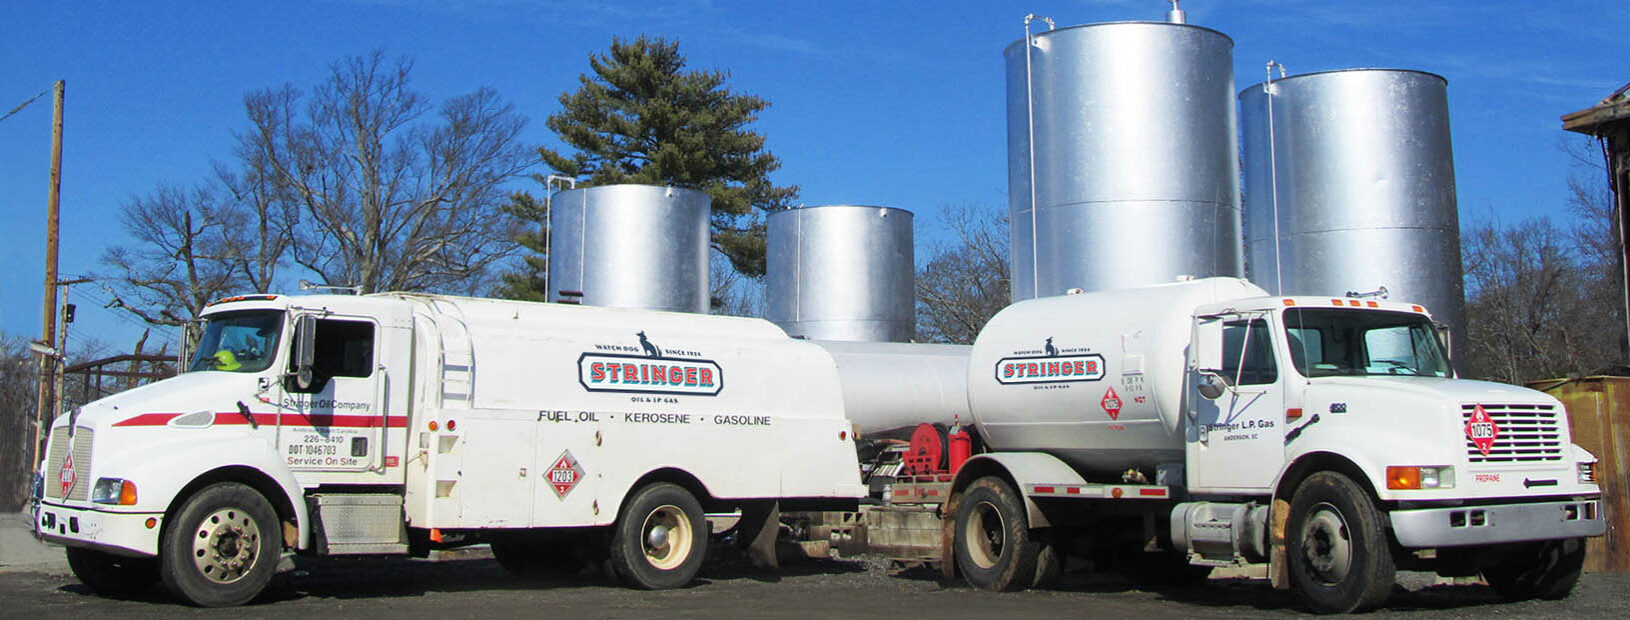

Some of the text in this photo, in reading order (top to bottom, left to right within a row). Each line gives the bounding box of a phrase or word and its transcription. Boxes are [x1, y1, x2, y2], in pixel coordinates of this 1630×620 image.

[591, 362, 714, 387] STRINGER
[1004, 361, 1099, 378] STRINGER
[331, 400, 371, 411] Company
[539, 410, 599, 422] FUEL OIL
[624, 413, 691, 424] KEROSENE
[714, 415, 771, 425] GASOLINE
[1208, 419, 1274, 432] Stringer L.P. Gas
[1472, 424, 1492, 437] 1075
[288, 457, 358, 465] Service On Site
[553, 470, 574, 482] 1203
[1475, 474, 1500, 482] PROPANE
